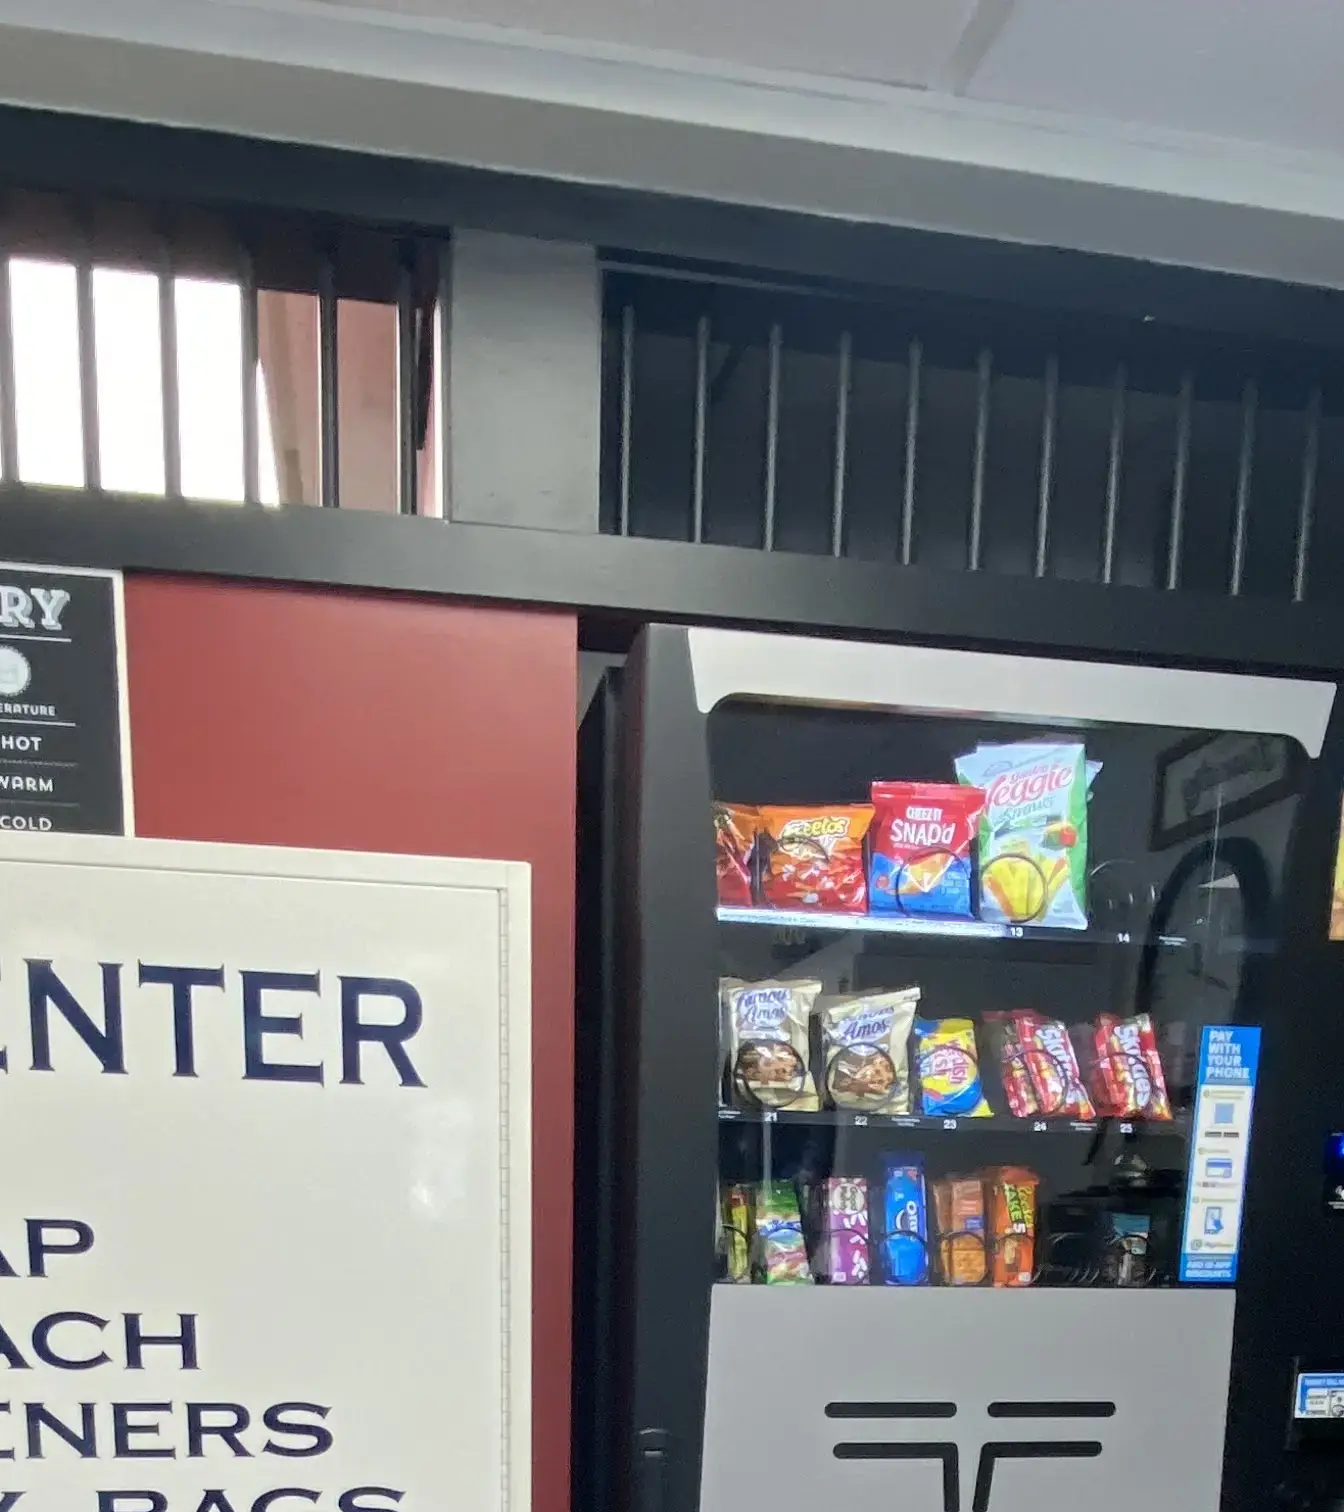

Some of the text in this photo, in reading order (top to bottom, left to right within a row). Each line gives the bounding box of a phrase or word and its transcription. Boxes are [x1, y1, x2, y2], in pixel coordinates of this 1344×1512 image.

[0, 735, 43, 752] HOT
[0, 816, 53, 831] COLD
[1009, 926, 1024, 938] 13
[1116, 932, 1130, 944] 14
[844, 1018, 890, 1040] Amos
[1210, 1031, 1233, 1043] PAY
[1209, 1043, 1241, 1055] WITH
[1207, 1055, 1242, 1067] YOUR
[1207, 1067, 1251, 1079] PHONE
[764, 1111, 778, 1122] 21
[854, 1116, 868, 1126] 22
[943, 1119, 957, 1130] 23
[1033, 1121, 1047, 1132] 24
